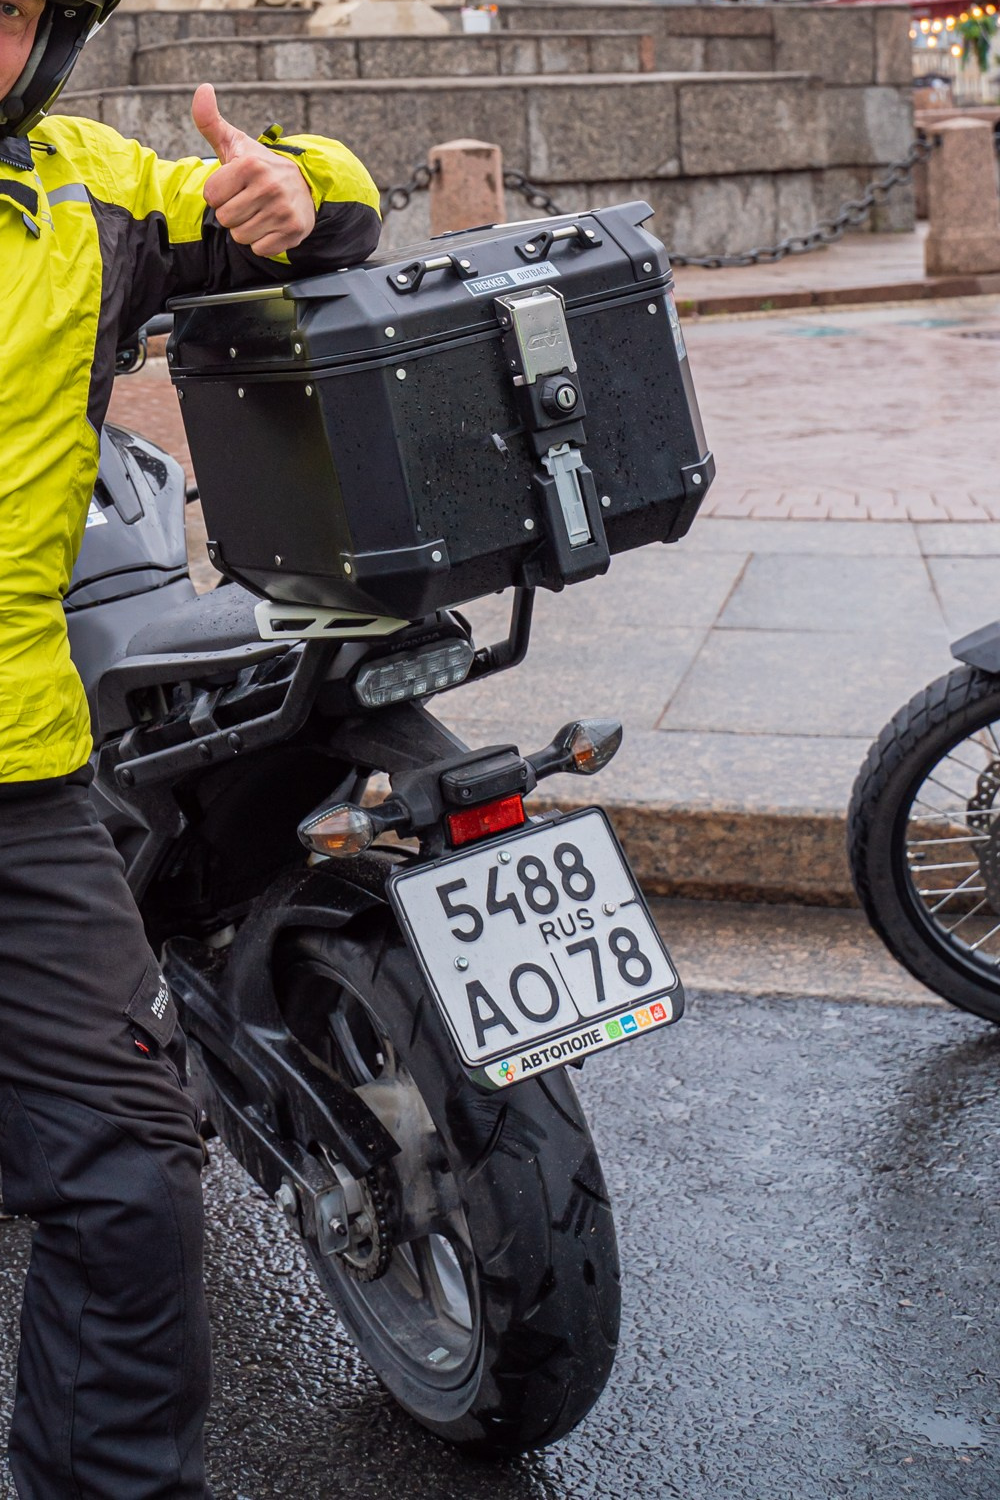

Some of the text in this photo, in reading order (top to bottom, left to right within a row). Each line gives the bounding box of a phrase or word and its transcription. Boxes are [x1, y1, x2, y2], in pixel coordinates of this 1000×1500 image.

[470, 265, 553, 292] TREKKER OUTBACK
[391, 632, 441, 651] HONDA
[435, 842, 596, 942] 5488
[538, 908, 595, 945] RUS
[565, 927, 653, 1002] 78
[520, 1028, 603, 1072] АВТОПОЛЕ
